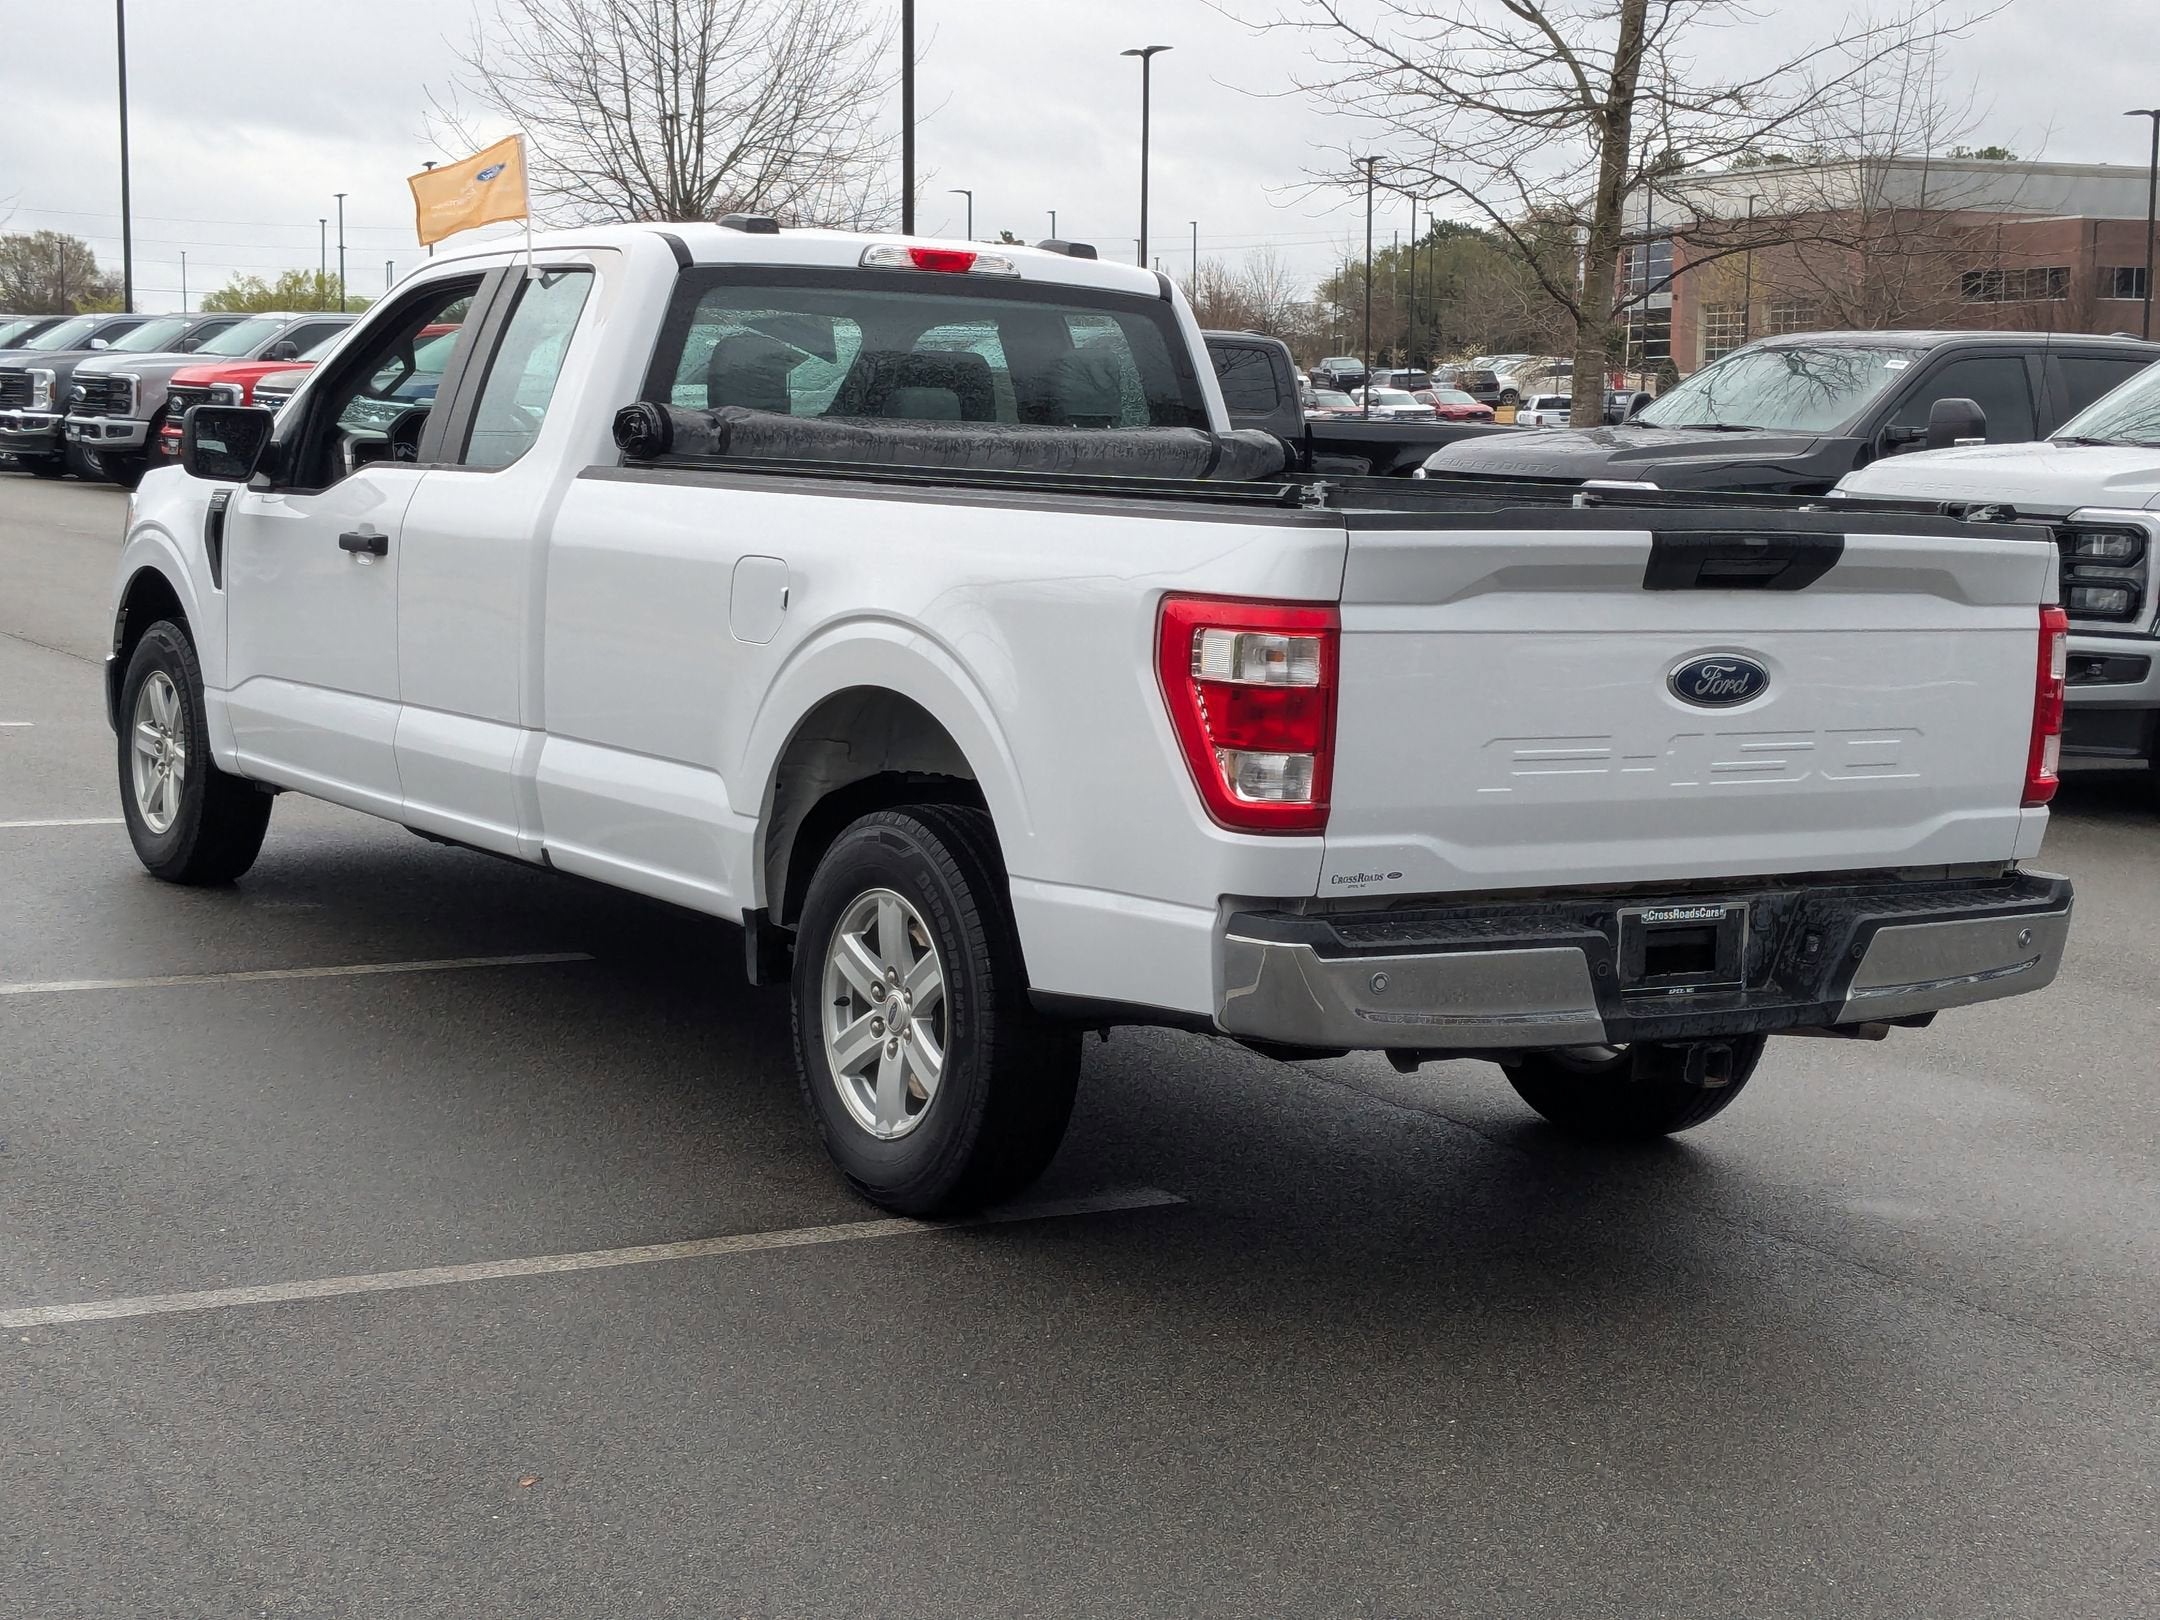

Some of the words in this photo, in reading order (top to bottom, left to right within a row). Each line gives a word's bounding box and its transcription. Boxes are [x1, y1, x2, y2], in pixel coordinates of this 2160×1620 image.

[1694, 663, 1750, 696] Ford
[1476, 727, 1925, 792] F-150
[1648, 908, 1719, 921] CrossRoadsCars
